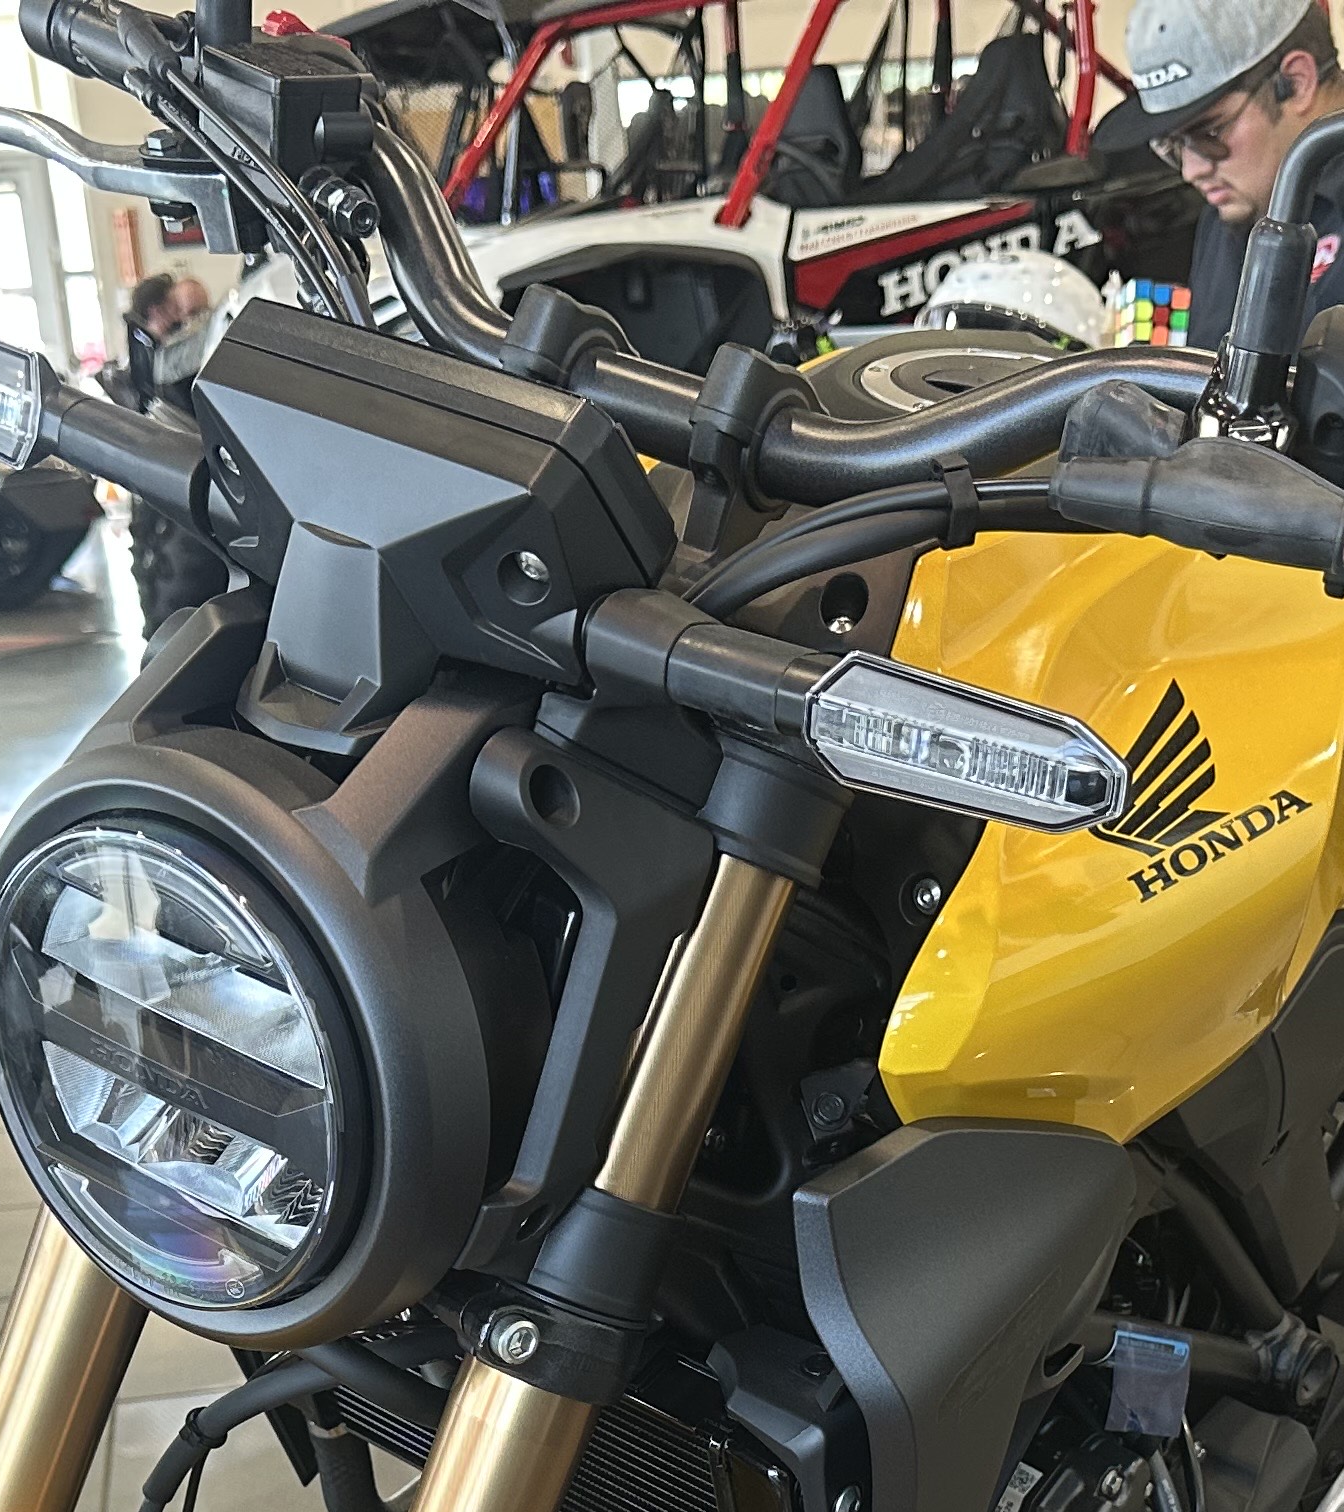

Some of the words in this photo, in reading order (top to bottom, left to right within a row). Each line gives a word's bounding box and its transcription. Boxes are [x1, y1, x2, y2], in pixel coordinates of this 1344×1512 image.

[1132, 62, 1189, 90] NDA
[1127, 790, 1313, 904] HONDA
[89, 1036, 209, 1110] HONDA
